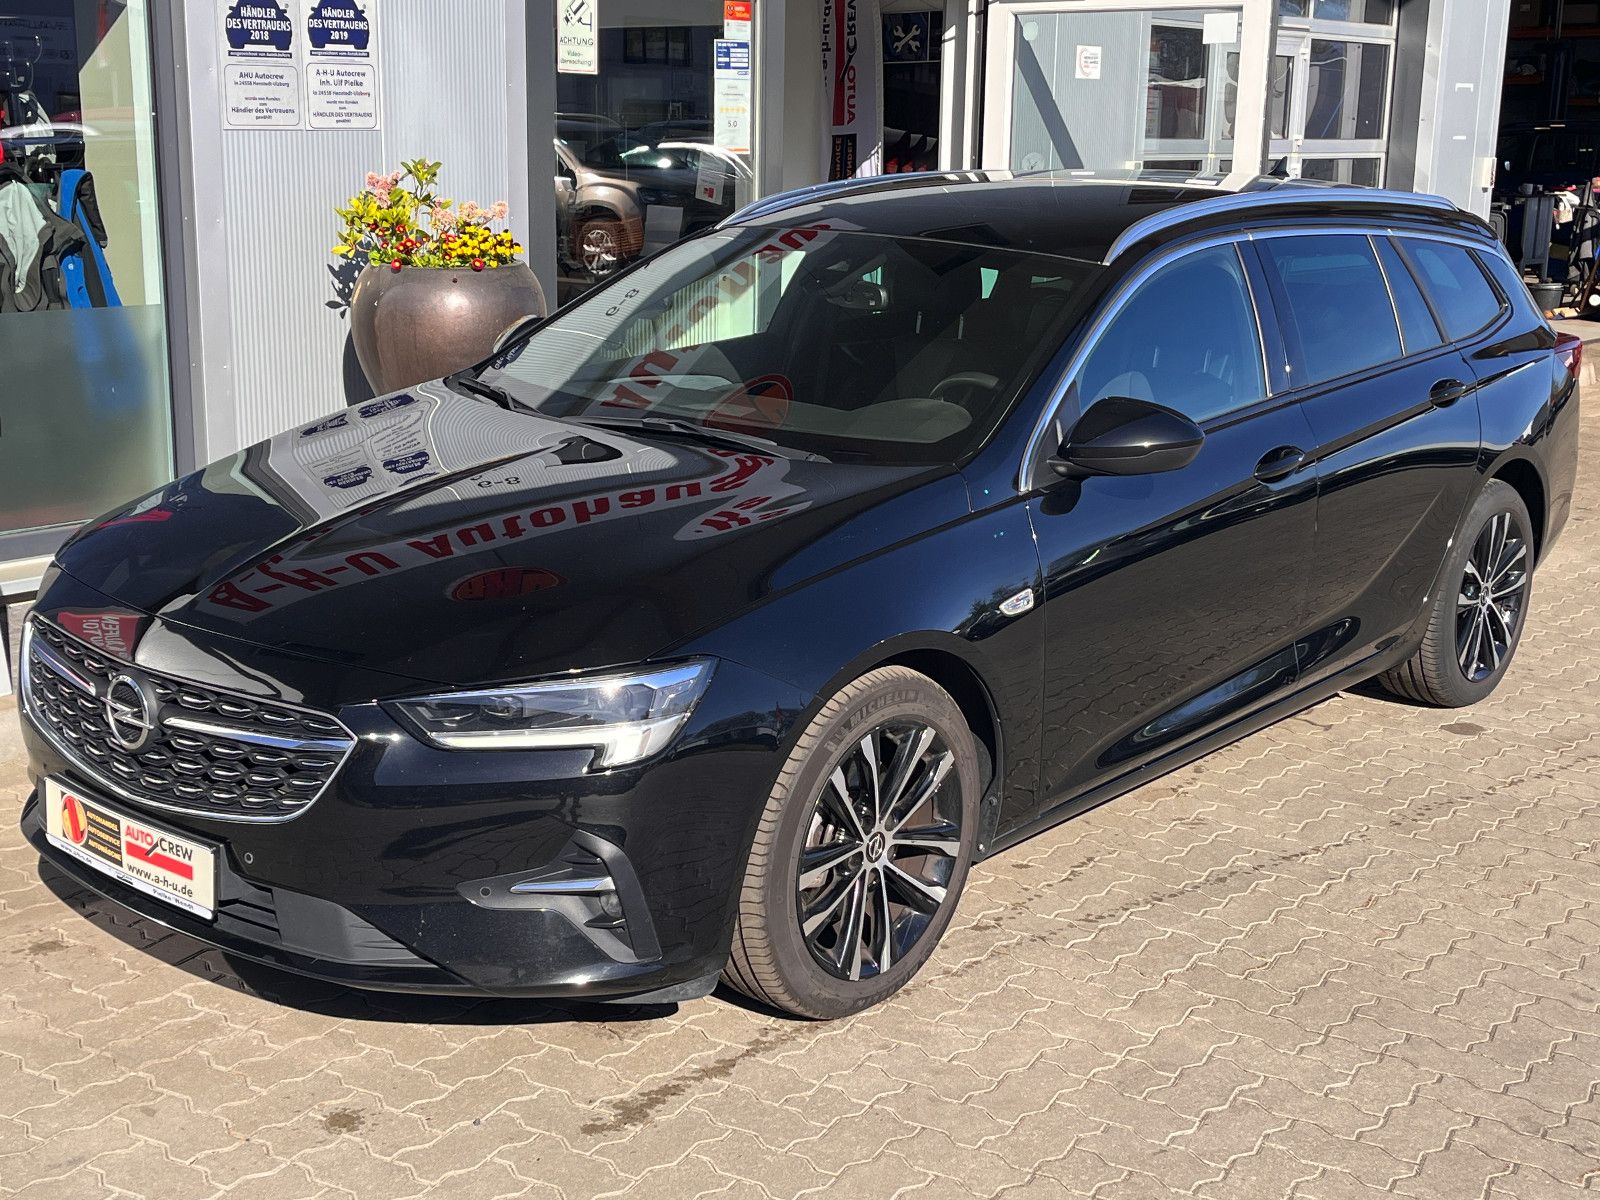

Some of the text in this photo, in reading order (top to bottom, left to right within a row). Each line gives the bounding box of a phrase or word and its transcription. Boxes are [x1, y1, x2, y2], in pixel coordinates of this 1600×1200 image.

[240, 5, 276, 19] HÄNDLER
[321, 7, 355, 19] HÄNDLER
[226, 18, 291, 32] DES VERTRAUENS
[308, 19, 368, 30] DES VERTRAUENS
[250, 30, 269, 40] 2018
[330, 30, 348, 40] 2019
[560, 36, 594, 46] ACHTUNG
[254, 72, 284, 80] Autocrew
[336, 69, 366, 77] Autocrew
[231, 106, 254, 114] Händler
[849, 689, 921, 728] MICHELIN
[125, 825, 193, 861] AUTO CREW
[127, 863, 193, 898] www.a-h-u.de
